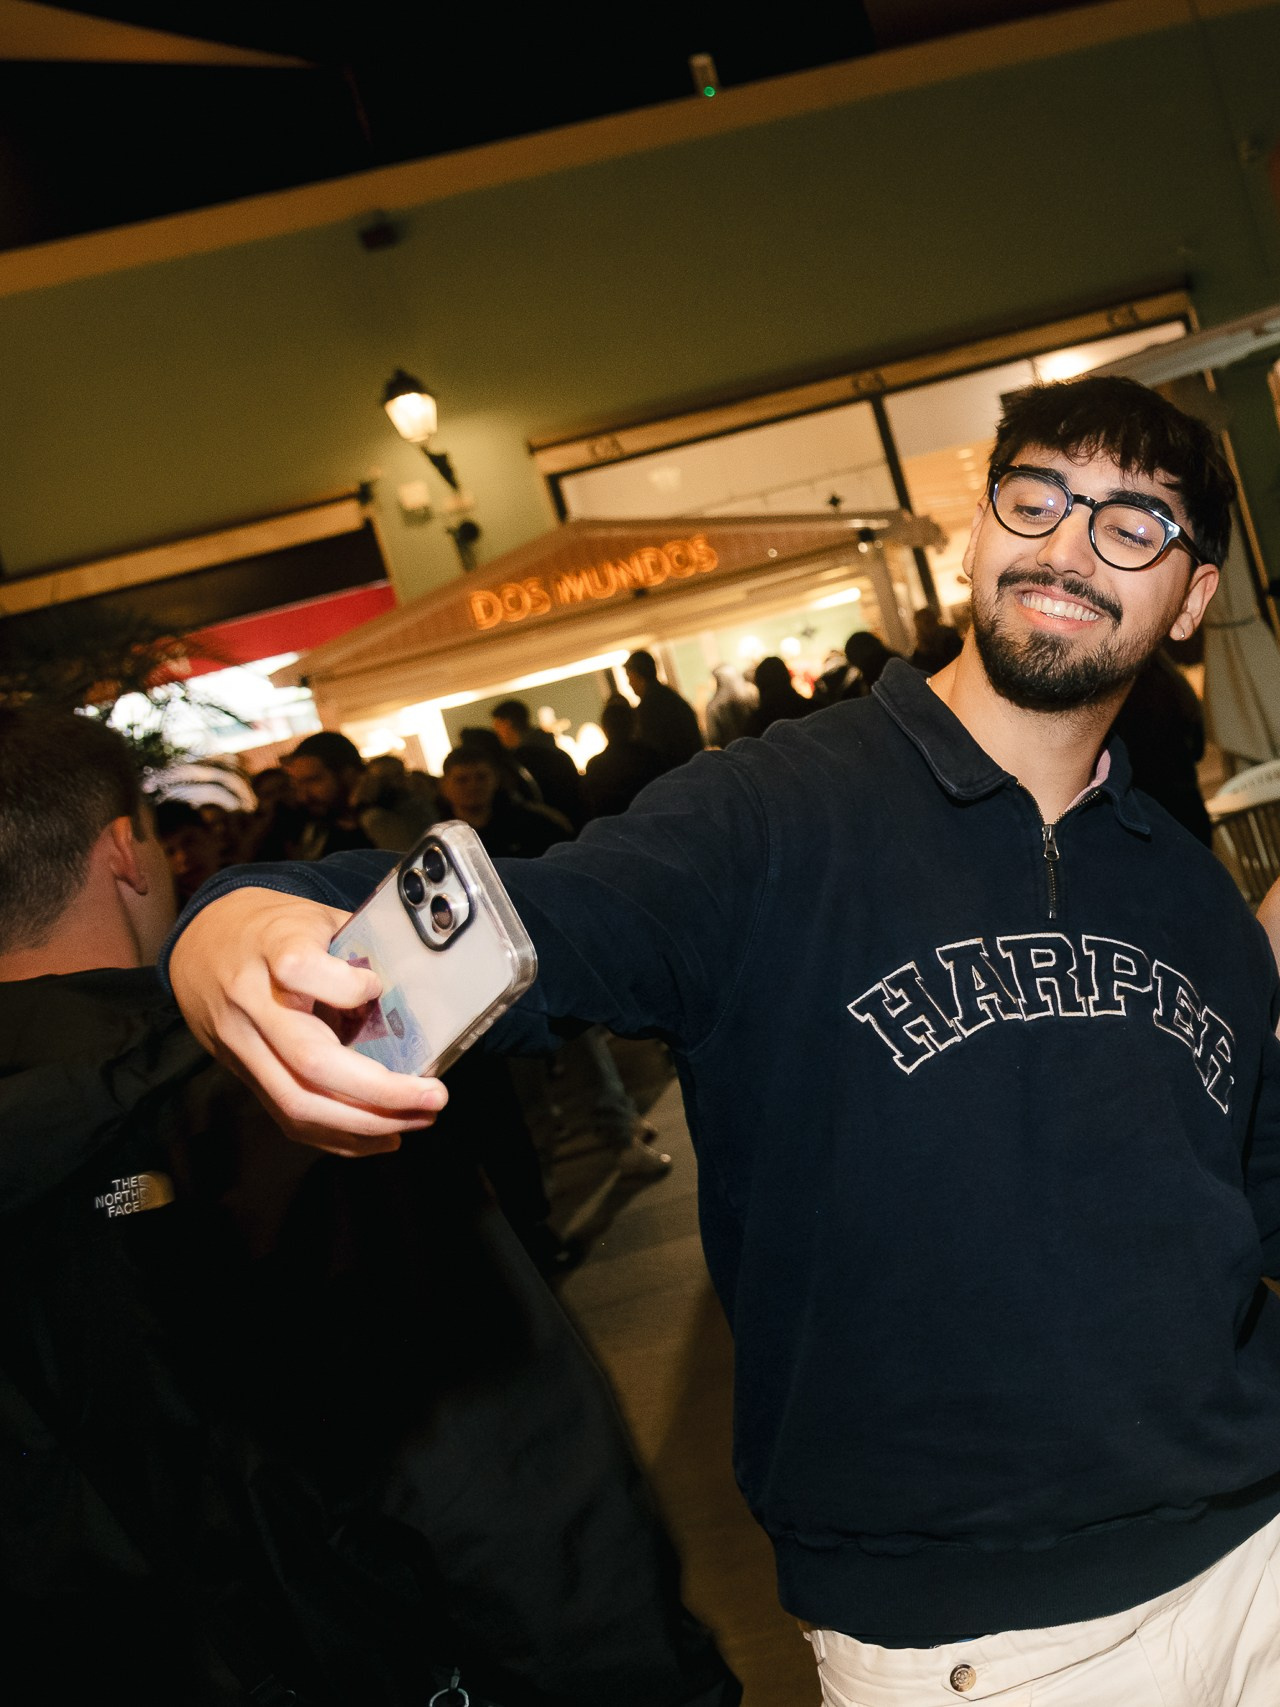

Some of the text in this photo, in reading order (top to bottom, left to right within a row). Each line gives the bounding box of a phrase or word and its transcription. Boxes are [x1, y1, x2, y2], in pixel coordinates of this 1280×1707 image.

[469, 534, 718, 630] DOS MUNDOS
[847, 932, 1235, 1114] HARPER
[111, 1176, 139, 1191] THE
[94, 1188, 139, 1209] NORTH
[107, 1201, 140, 1218] FACE
